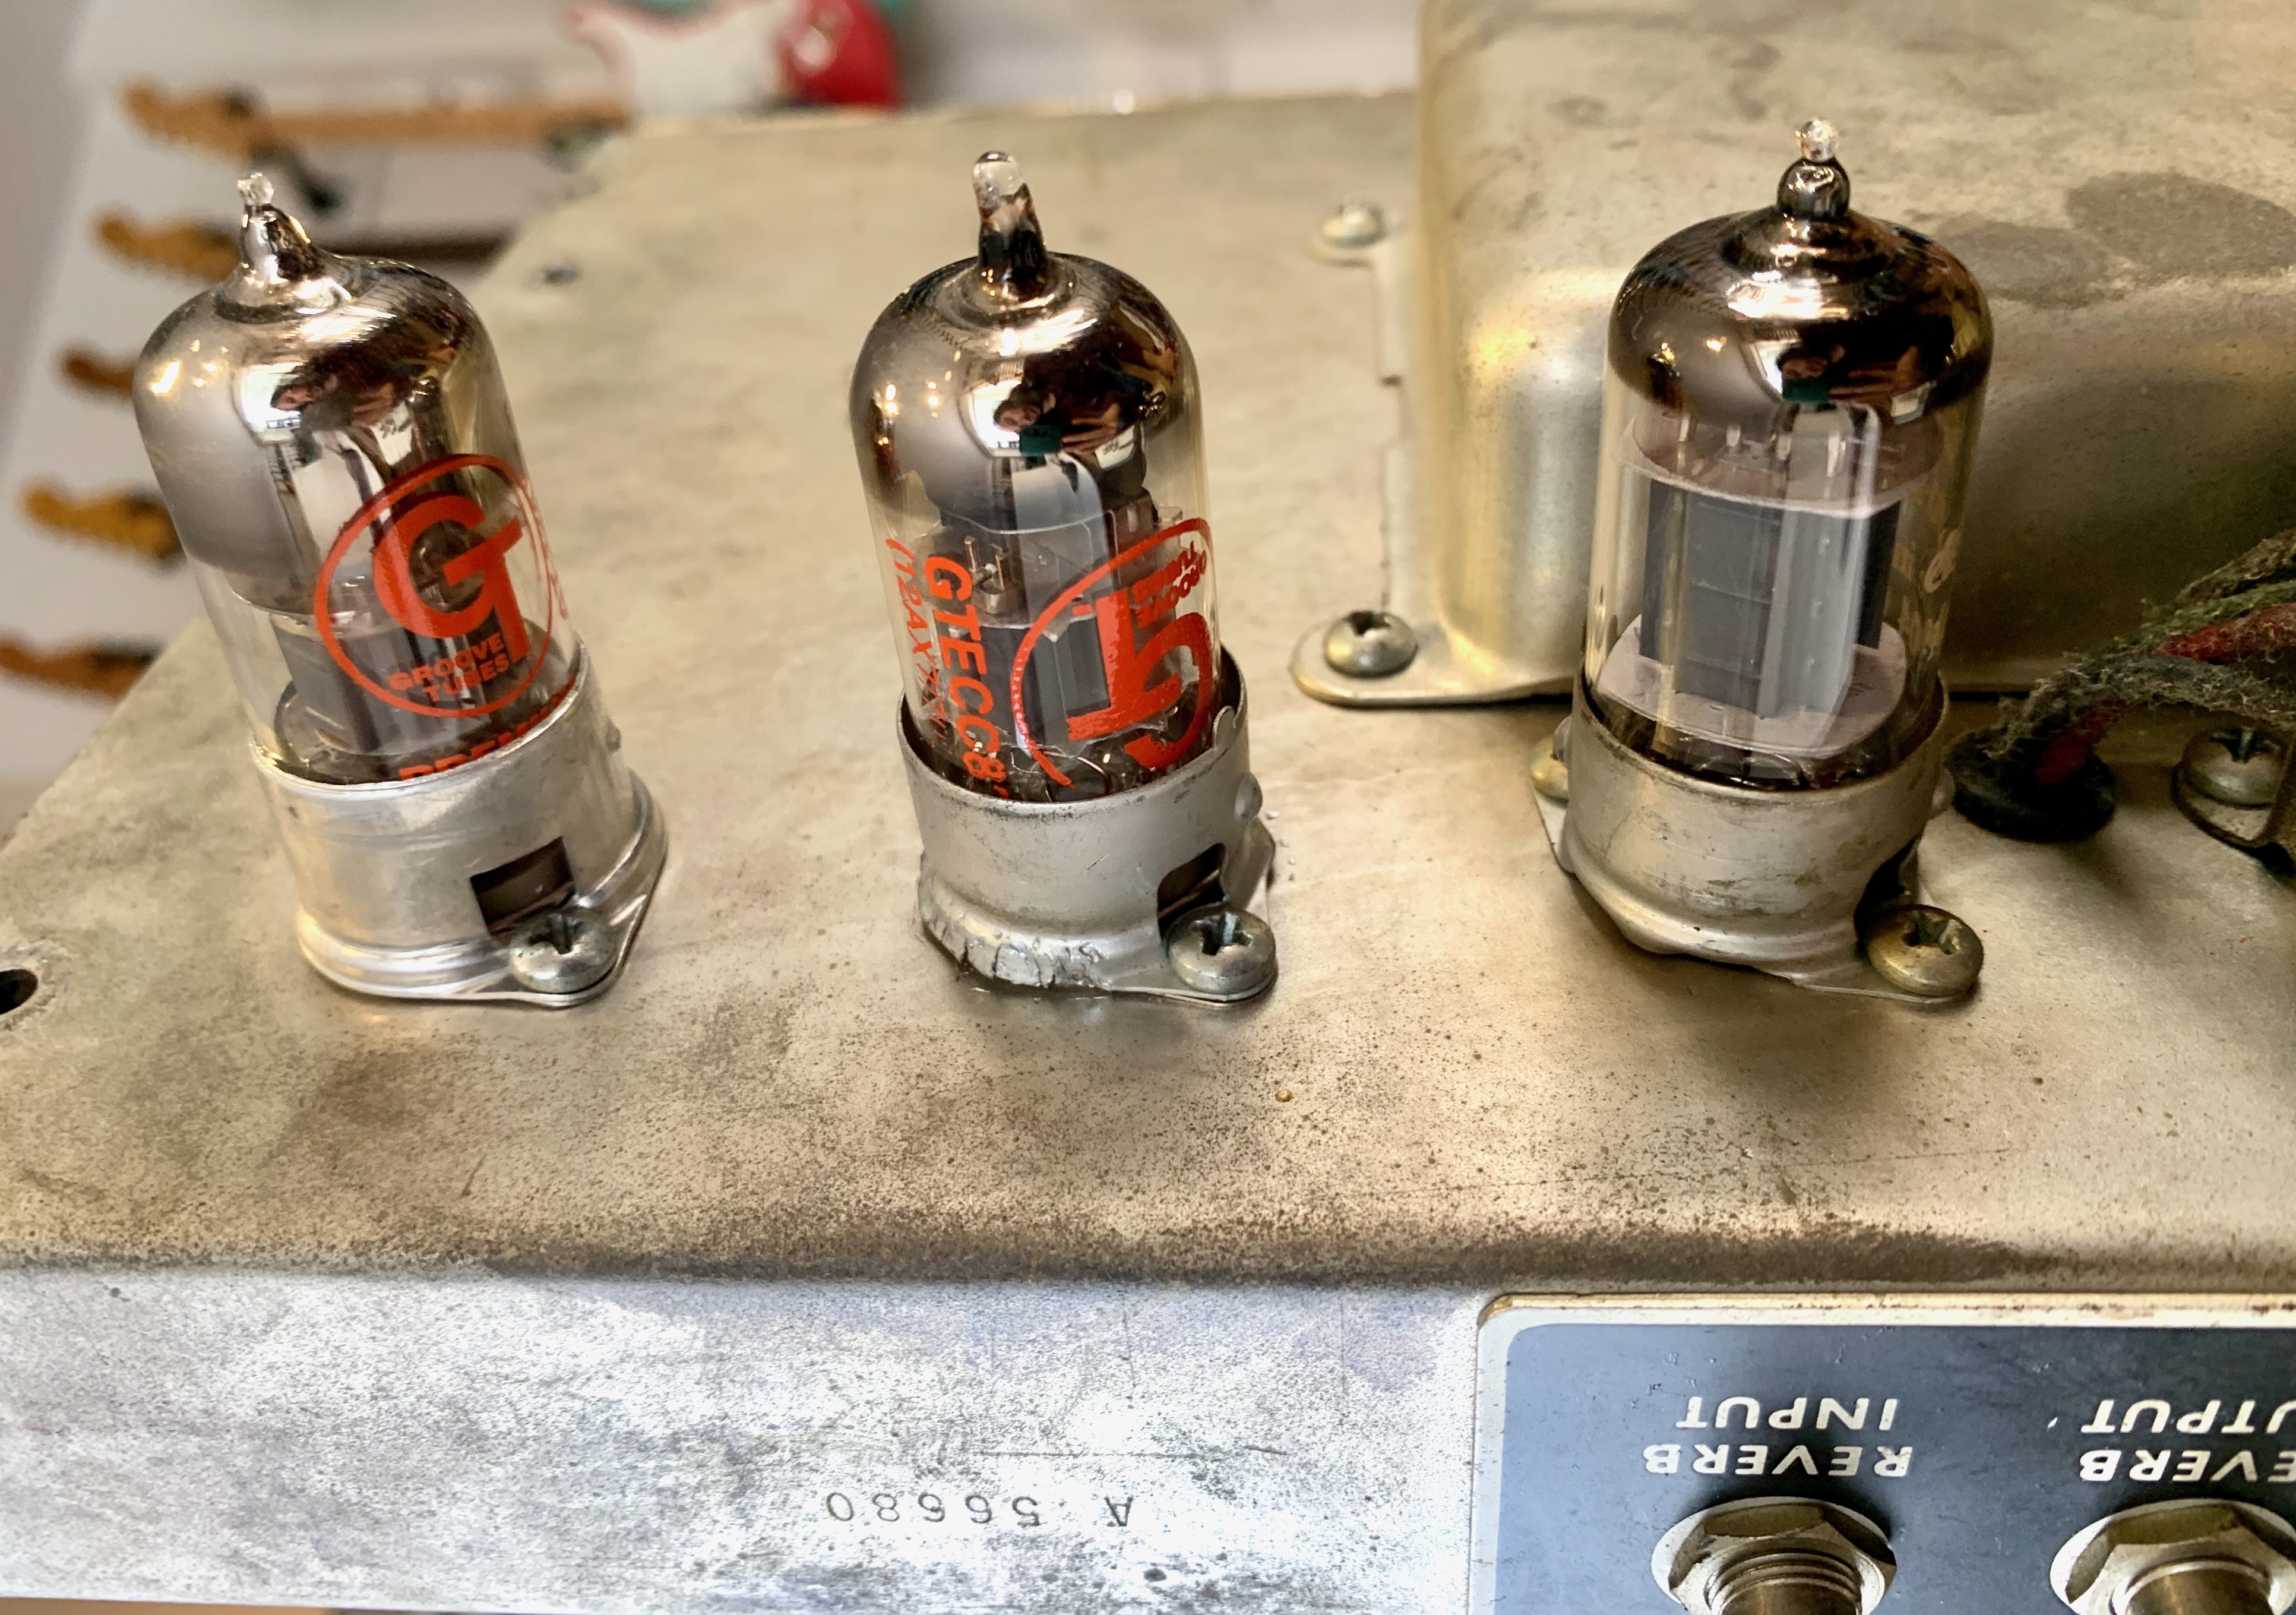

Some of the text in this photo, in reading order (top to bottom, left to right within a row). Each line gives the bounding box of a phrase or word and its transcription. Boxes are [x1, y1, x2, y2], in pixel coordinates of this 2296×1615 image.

[388, 632, 504, 691] GROOVE
[422, 653, 510, 702] TUBES
[1675, 1396, 1899, 1431] INPUT
[1642, 1443, 1913, 1477] REVERB
[826, 1491, 1133, 1526] A 56680
